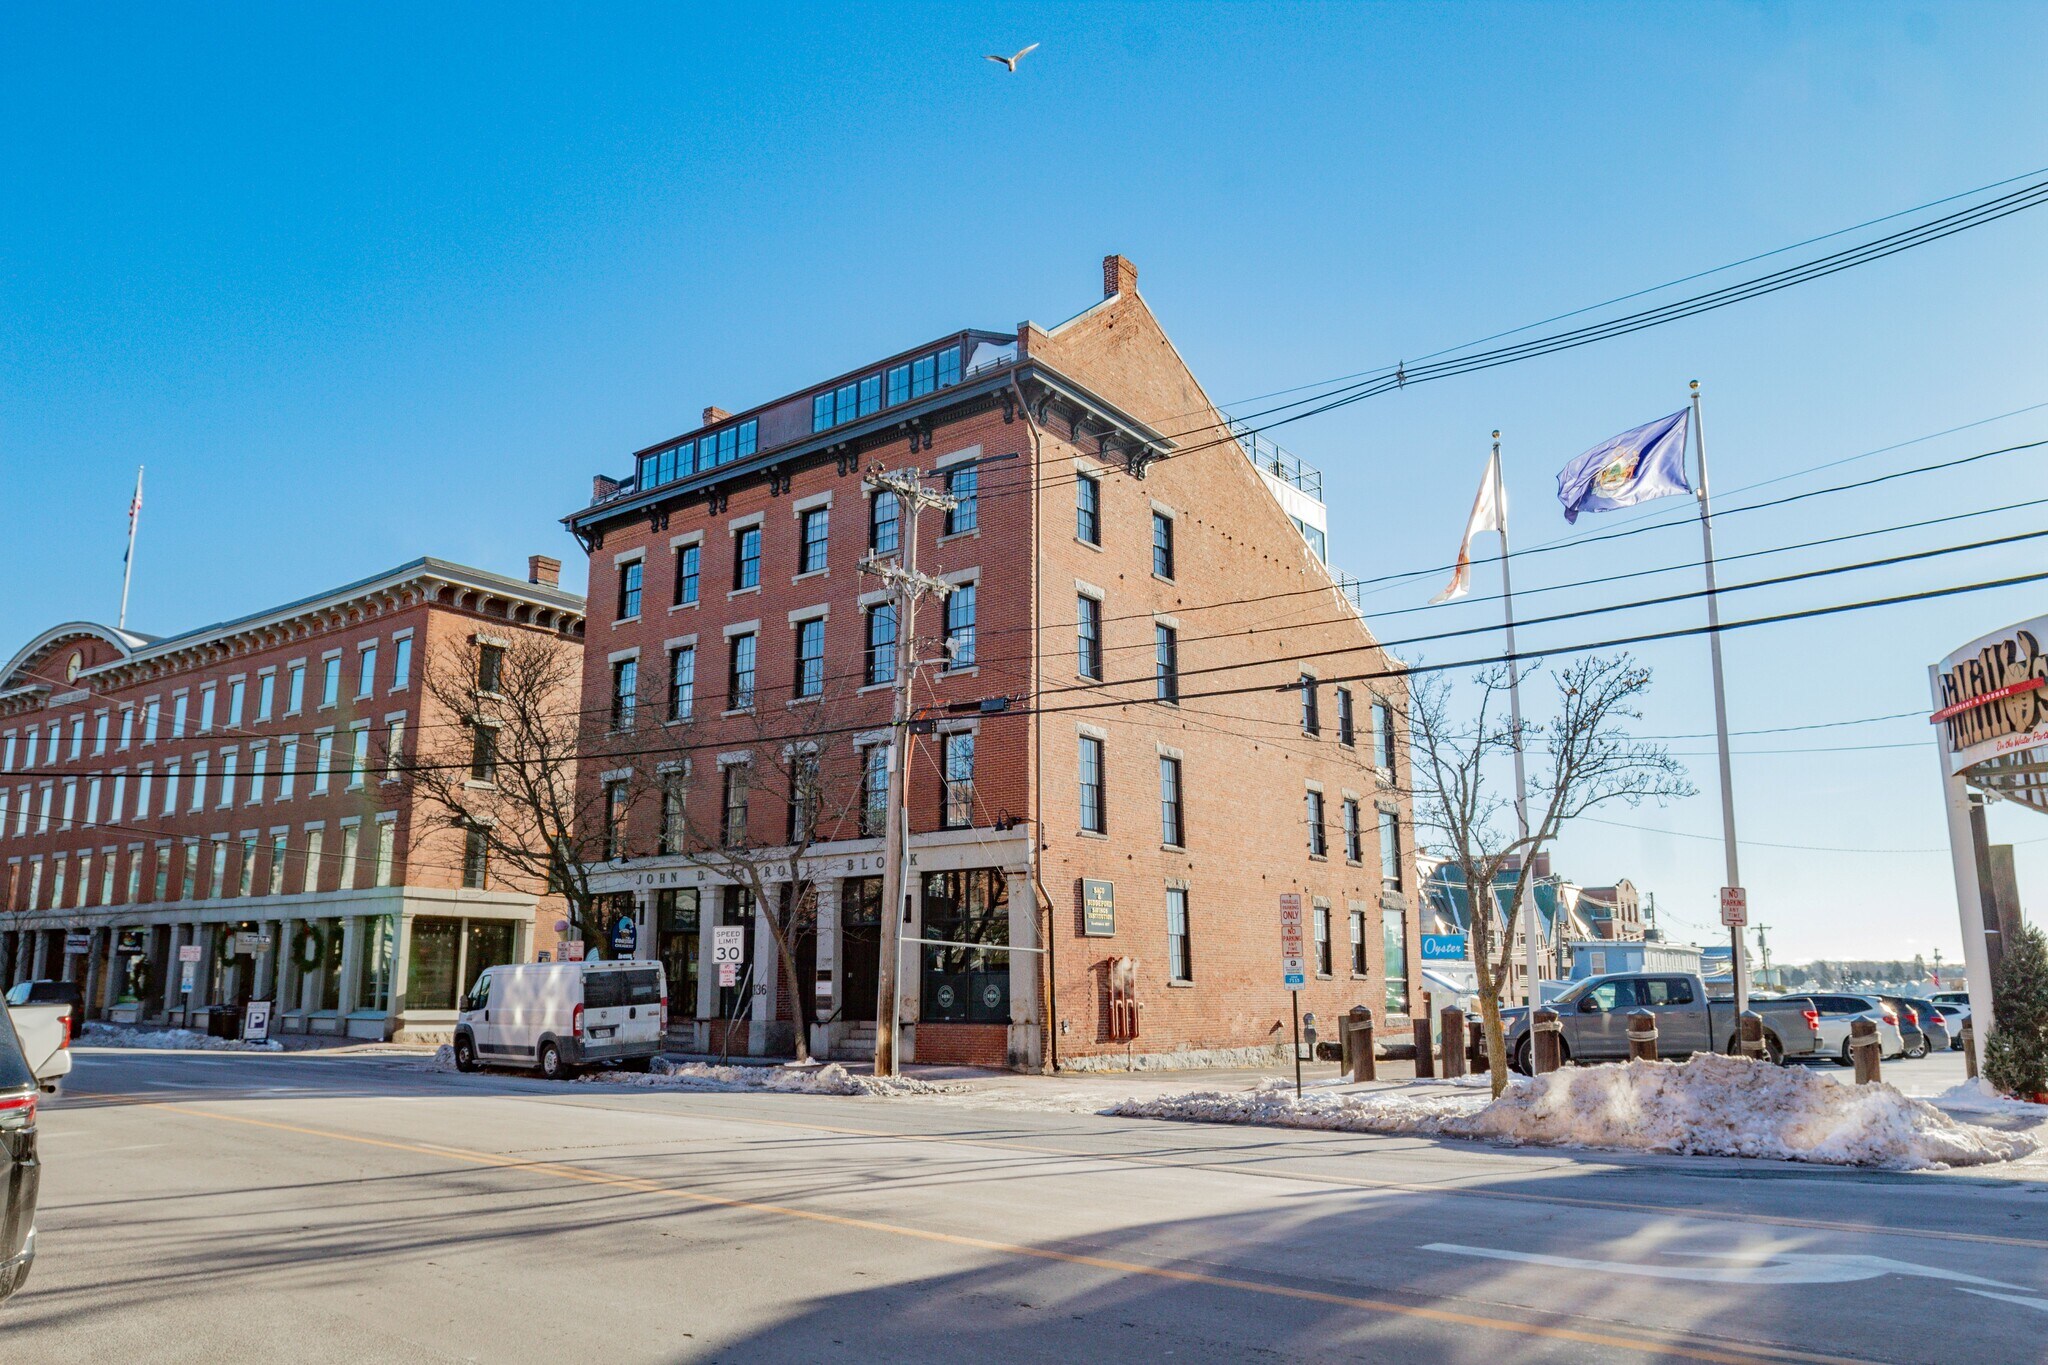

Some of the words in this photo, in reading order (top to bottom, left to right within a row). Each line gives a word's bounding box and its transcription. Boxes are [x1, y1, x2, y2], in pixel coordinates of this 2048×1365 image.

[1982, 688, 2010, 702] LOUNGE
[636, 872, 678, 885] JOHN
[726, 863, 813, 880] CAROL
[847, 853, 918, 871] BLOK
[1283, 911, 1299, 919] ONLY
[716, 947, 740, 960] 30
[1424, 938, 1462, 956] Oyster
[753, 984, 767, 996] 136
